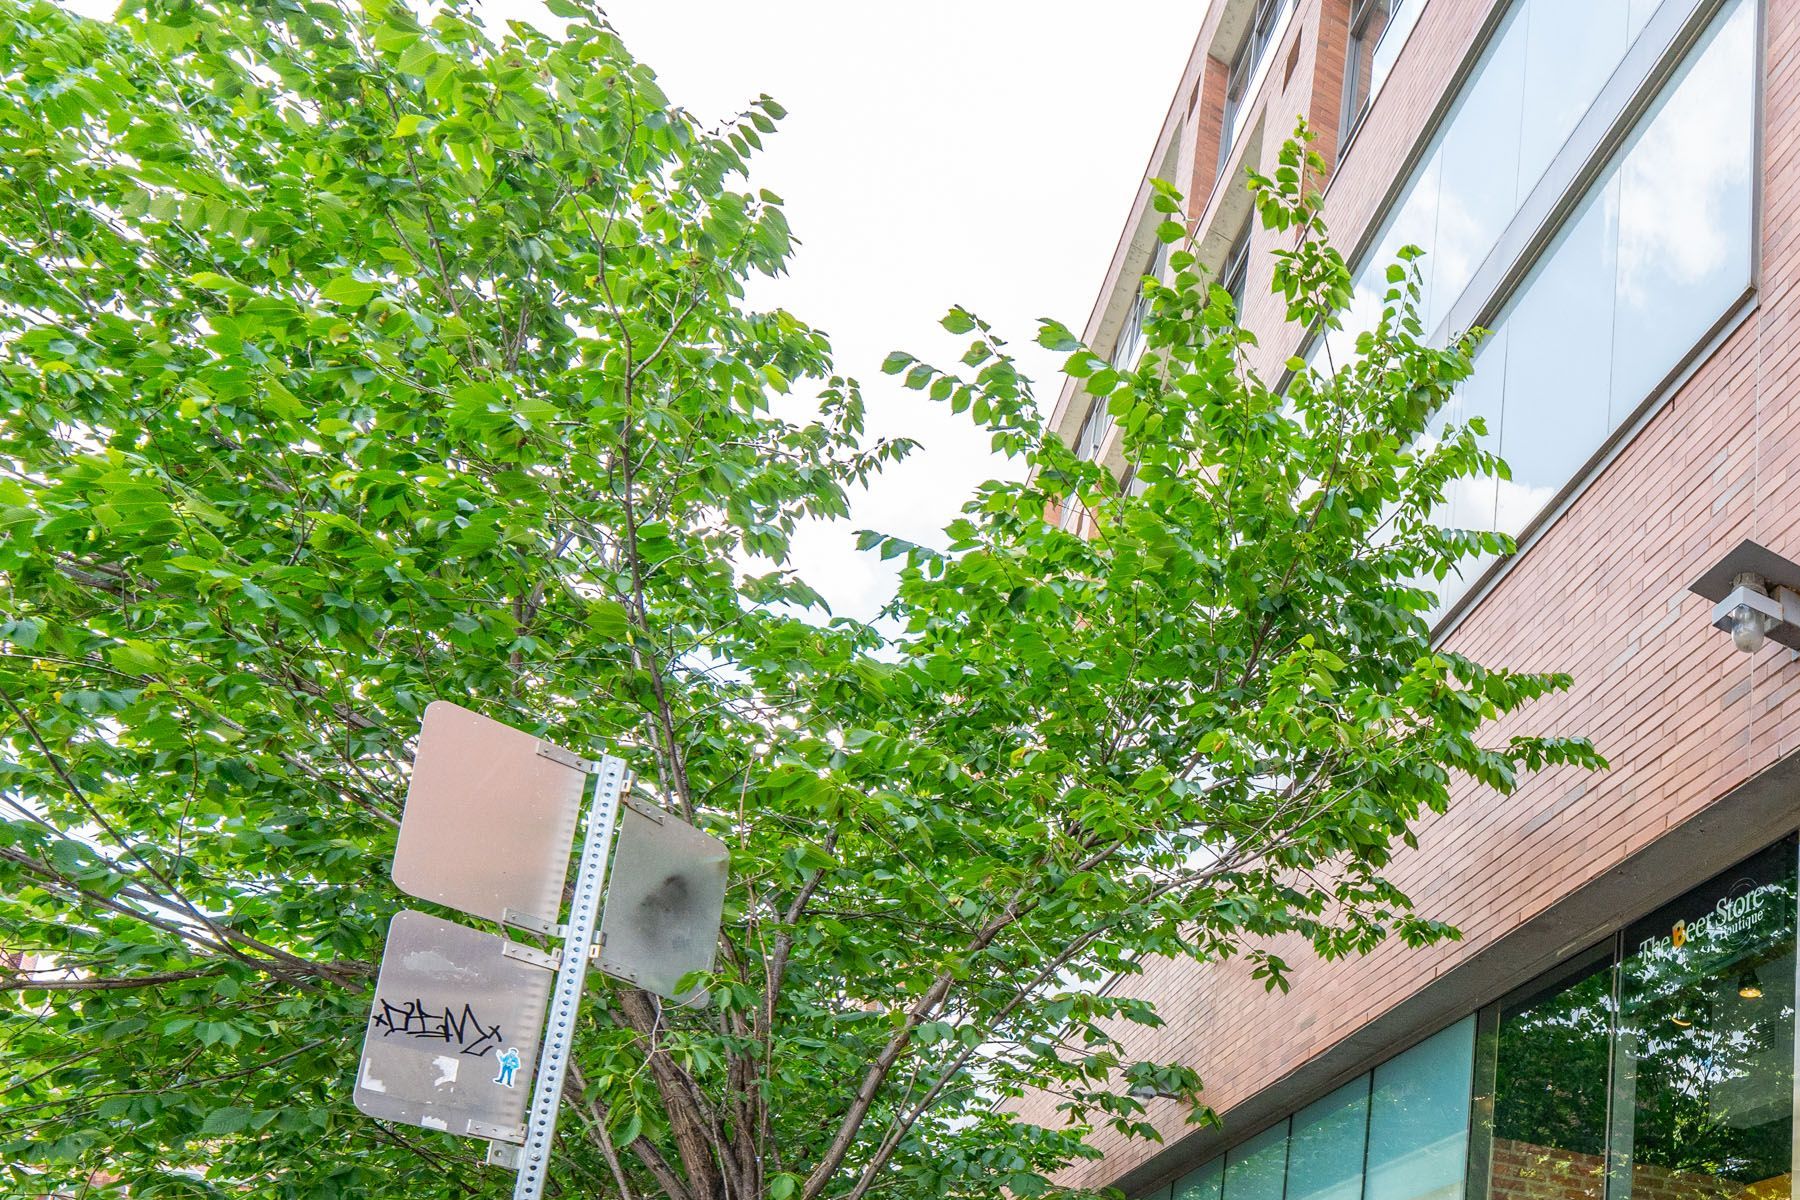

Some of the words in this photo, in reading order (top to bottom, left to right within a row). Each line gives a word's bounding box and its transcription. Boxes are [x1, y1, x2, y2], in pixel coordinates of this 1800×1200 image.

[1639, 935, 1671, 966] The
[1672, 911, 1714, 948] Beer
[1716, 885, 1765, 927] Store
